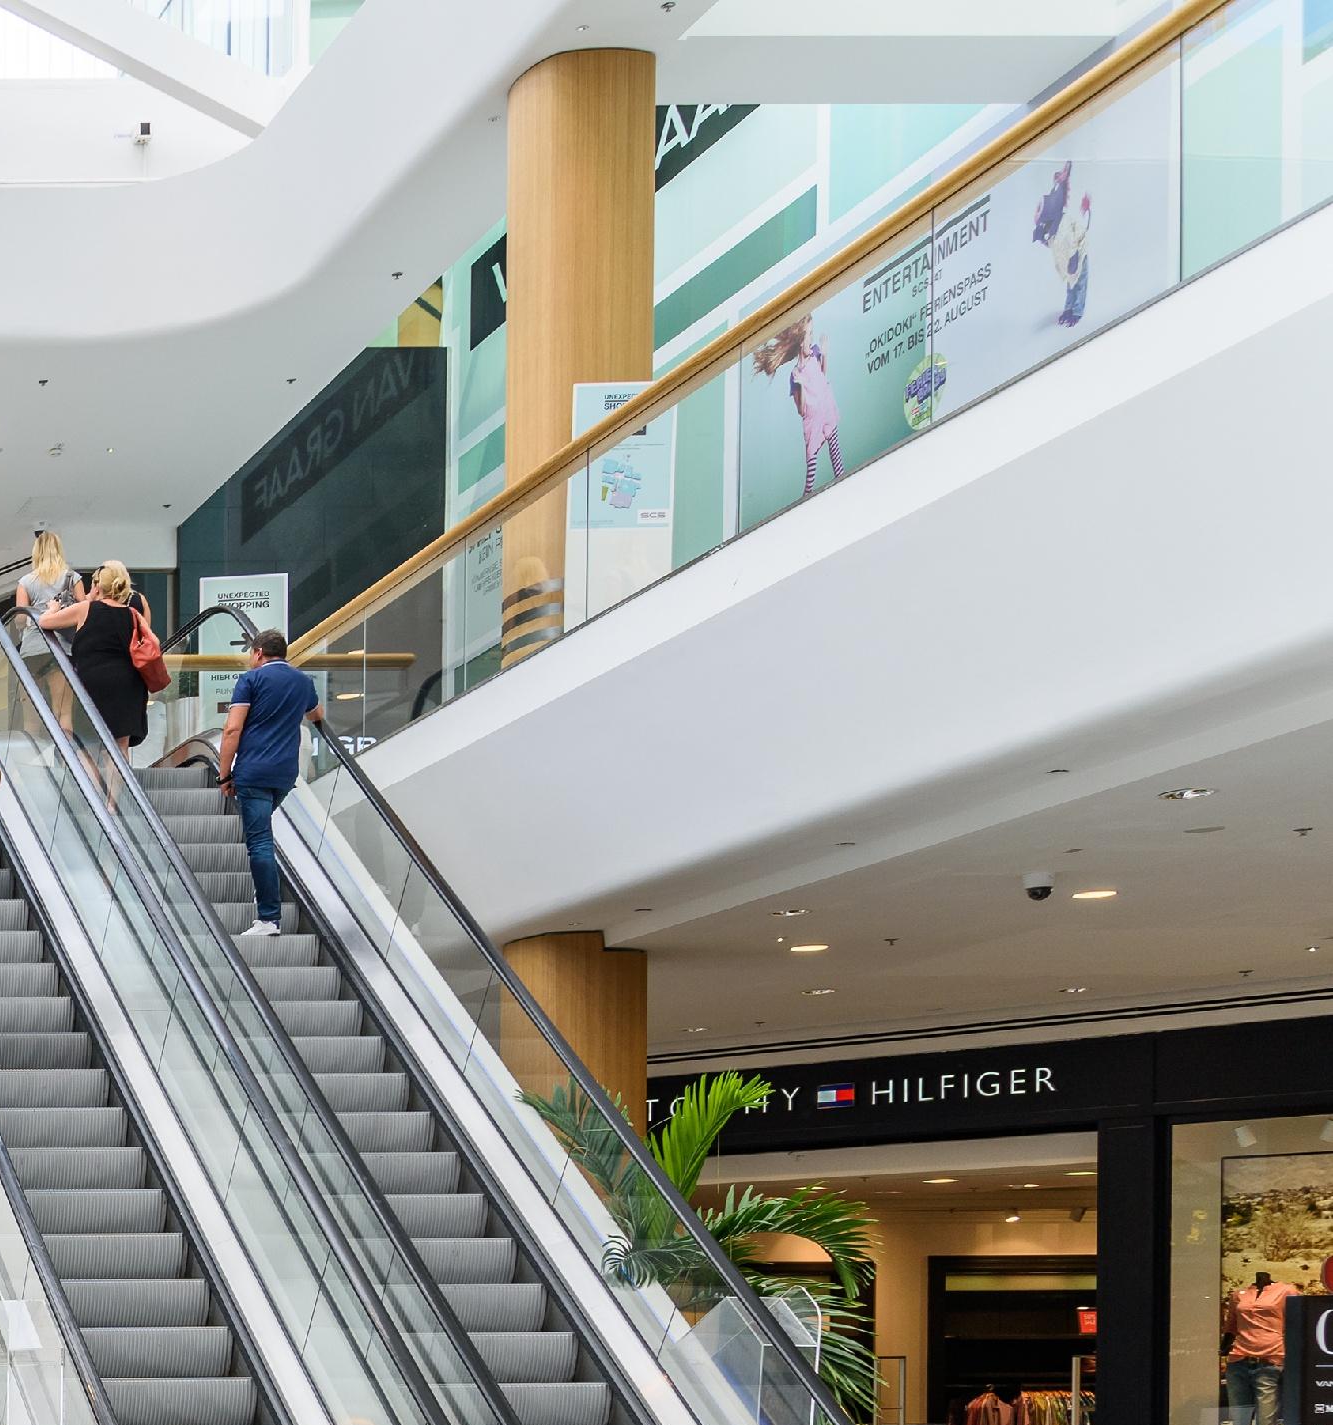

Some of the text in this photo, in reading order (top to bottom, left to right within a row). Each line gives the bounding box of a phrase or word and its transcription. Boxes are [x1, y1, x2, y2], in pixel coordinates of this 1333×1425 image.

[919, 263, 992, 323] FERIENSPASS
[867, 349, 890, 375] VOM
[893, 341, 905, 358] 17.
[907, 328, 925, 351] BIS
[944, 286, 989, 324] AUGUST
[217, 591, 270, 600] UNEXPECTED
[871, 1067, 1056, 1106] HILFIGER
